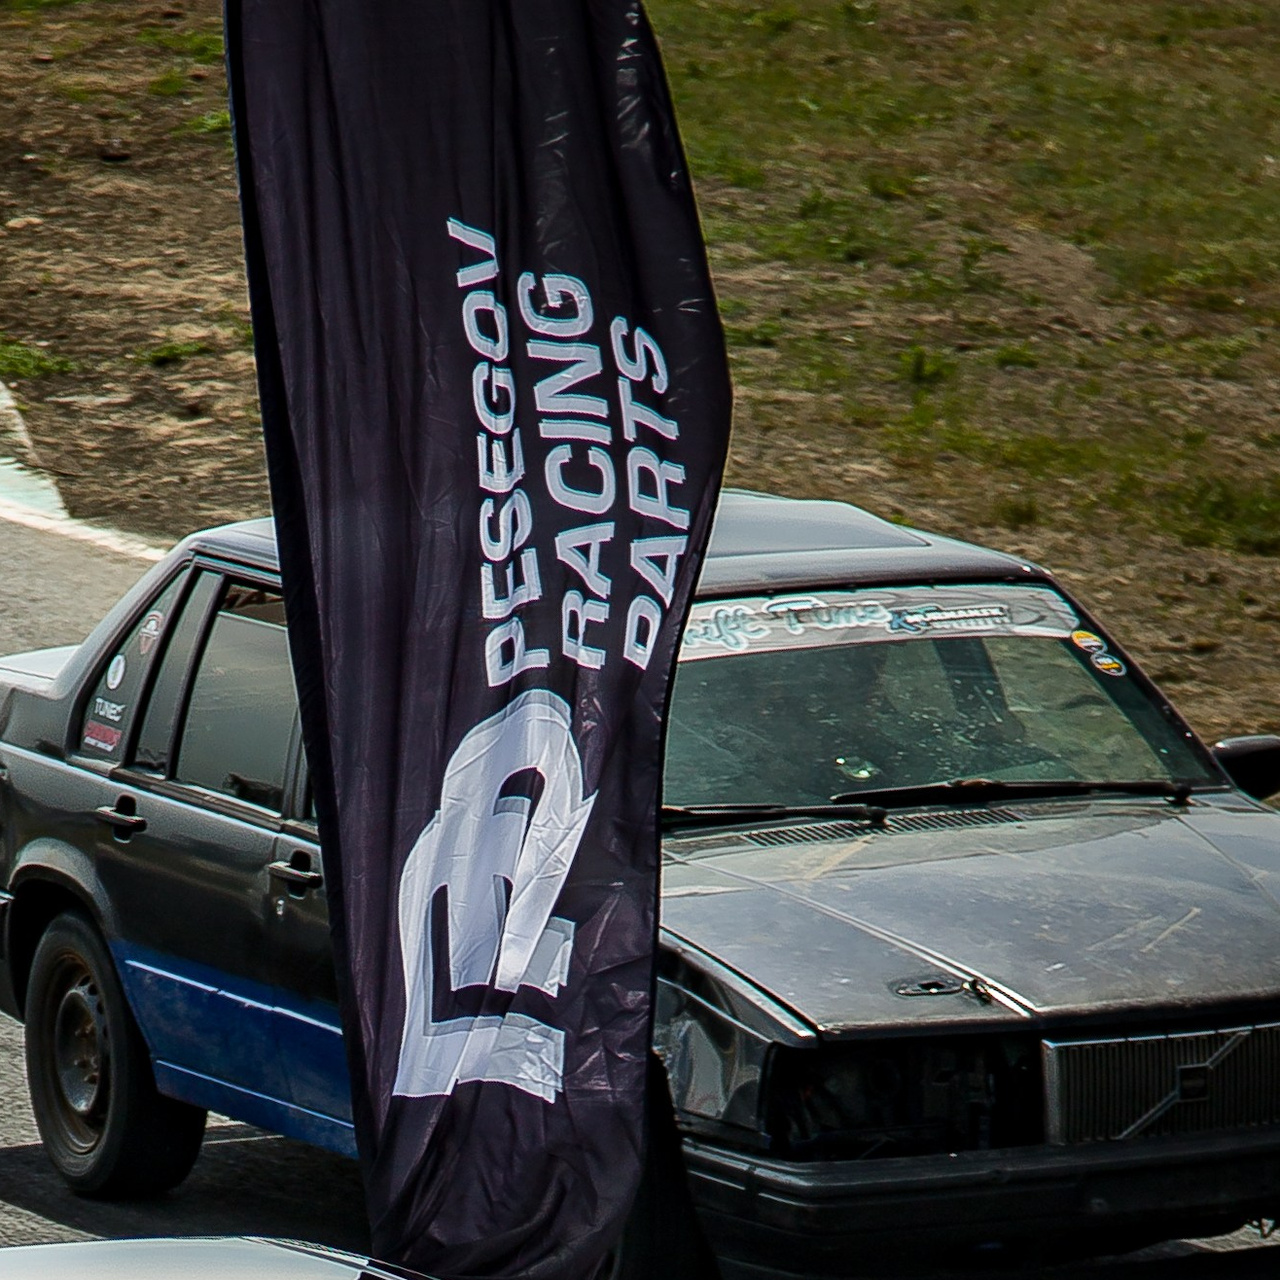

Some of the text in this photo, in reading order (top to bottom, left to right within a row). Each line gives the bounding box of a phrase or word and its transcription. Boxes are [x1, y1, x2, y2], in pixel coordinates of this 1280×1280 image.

[447, 217, 550, 687] PESEGOV
[517, 272, 616, 669] RACING
[610, 316, 690, 670] PARTS
